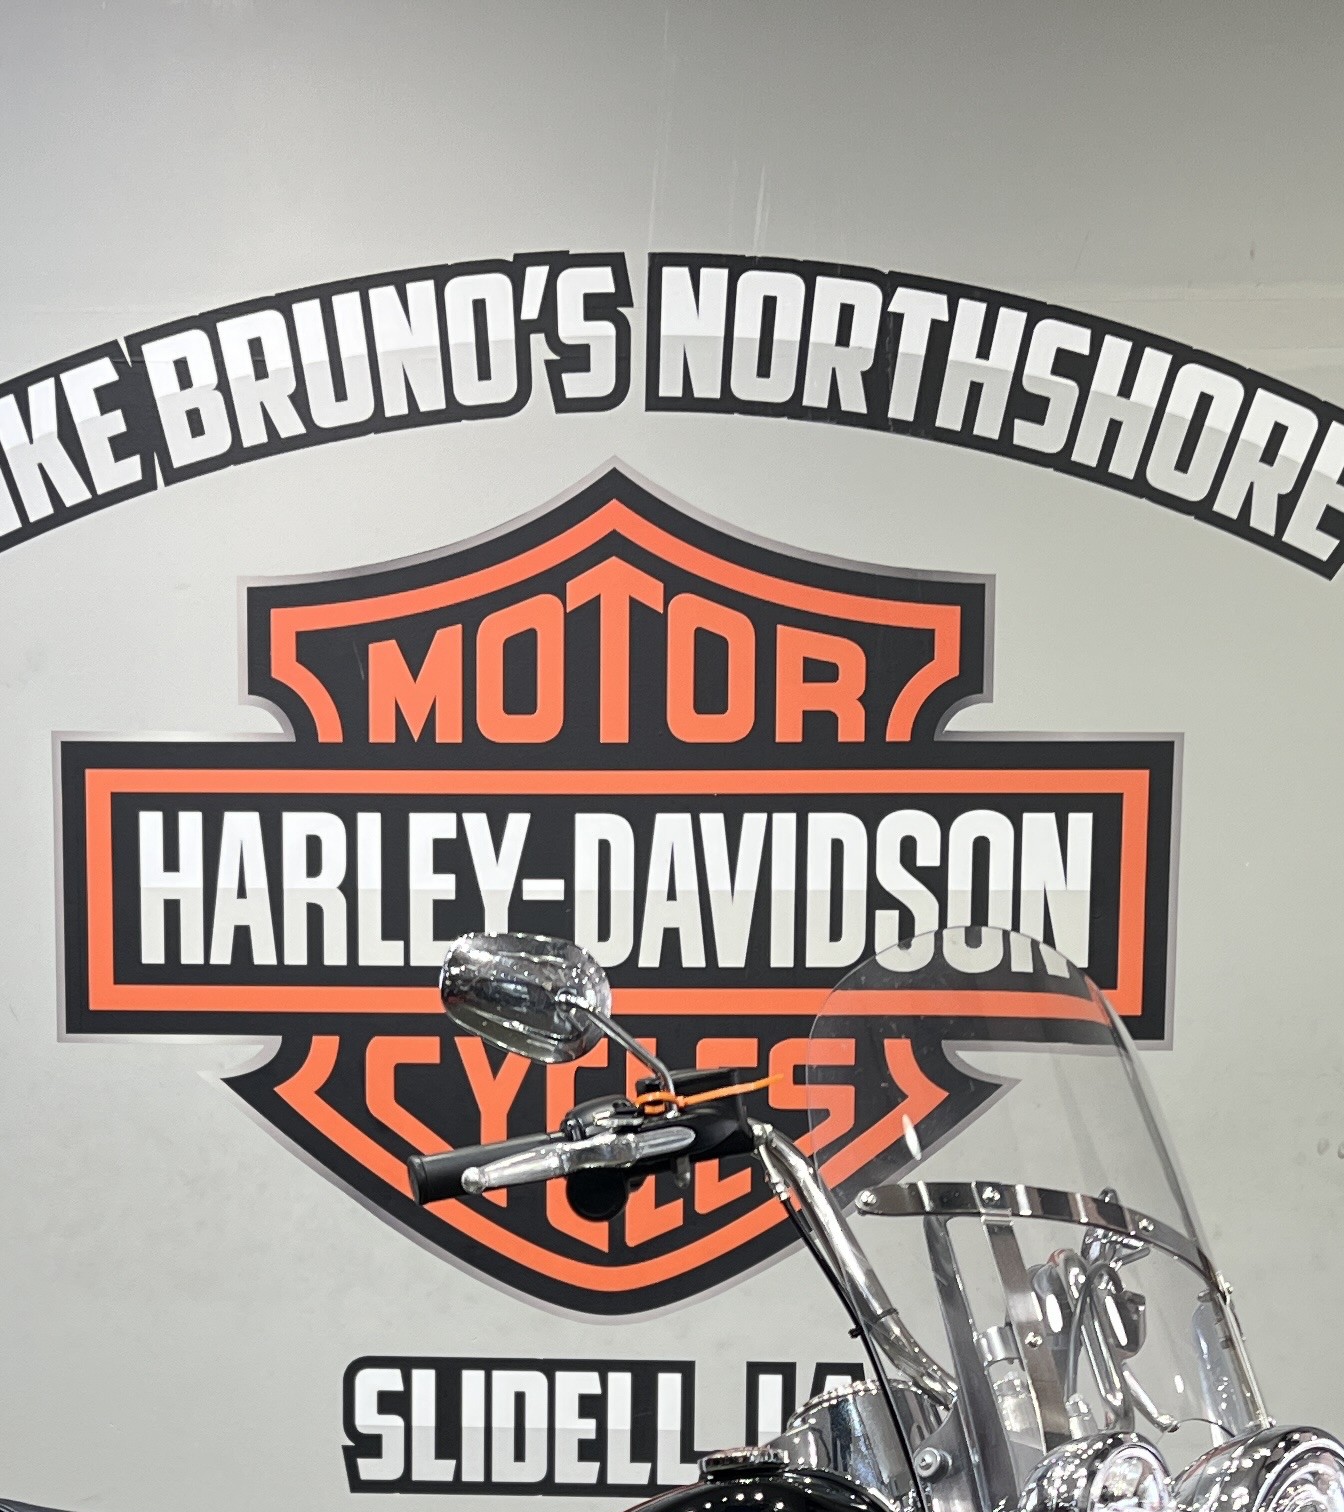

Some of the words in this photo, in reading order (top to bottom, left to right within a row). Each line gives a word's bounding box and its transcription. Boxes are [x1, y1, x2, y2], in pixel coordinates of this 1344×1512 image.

[136, 260, 622, 473] BRUNO'S
[367, 553, 868, 745] MOTOR
[136, 807, 1094, 979] HARLEY-DAVIDSON
[352, 1364, 702, 1488] SLIDELL
